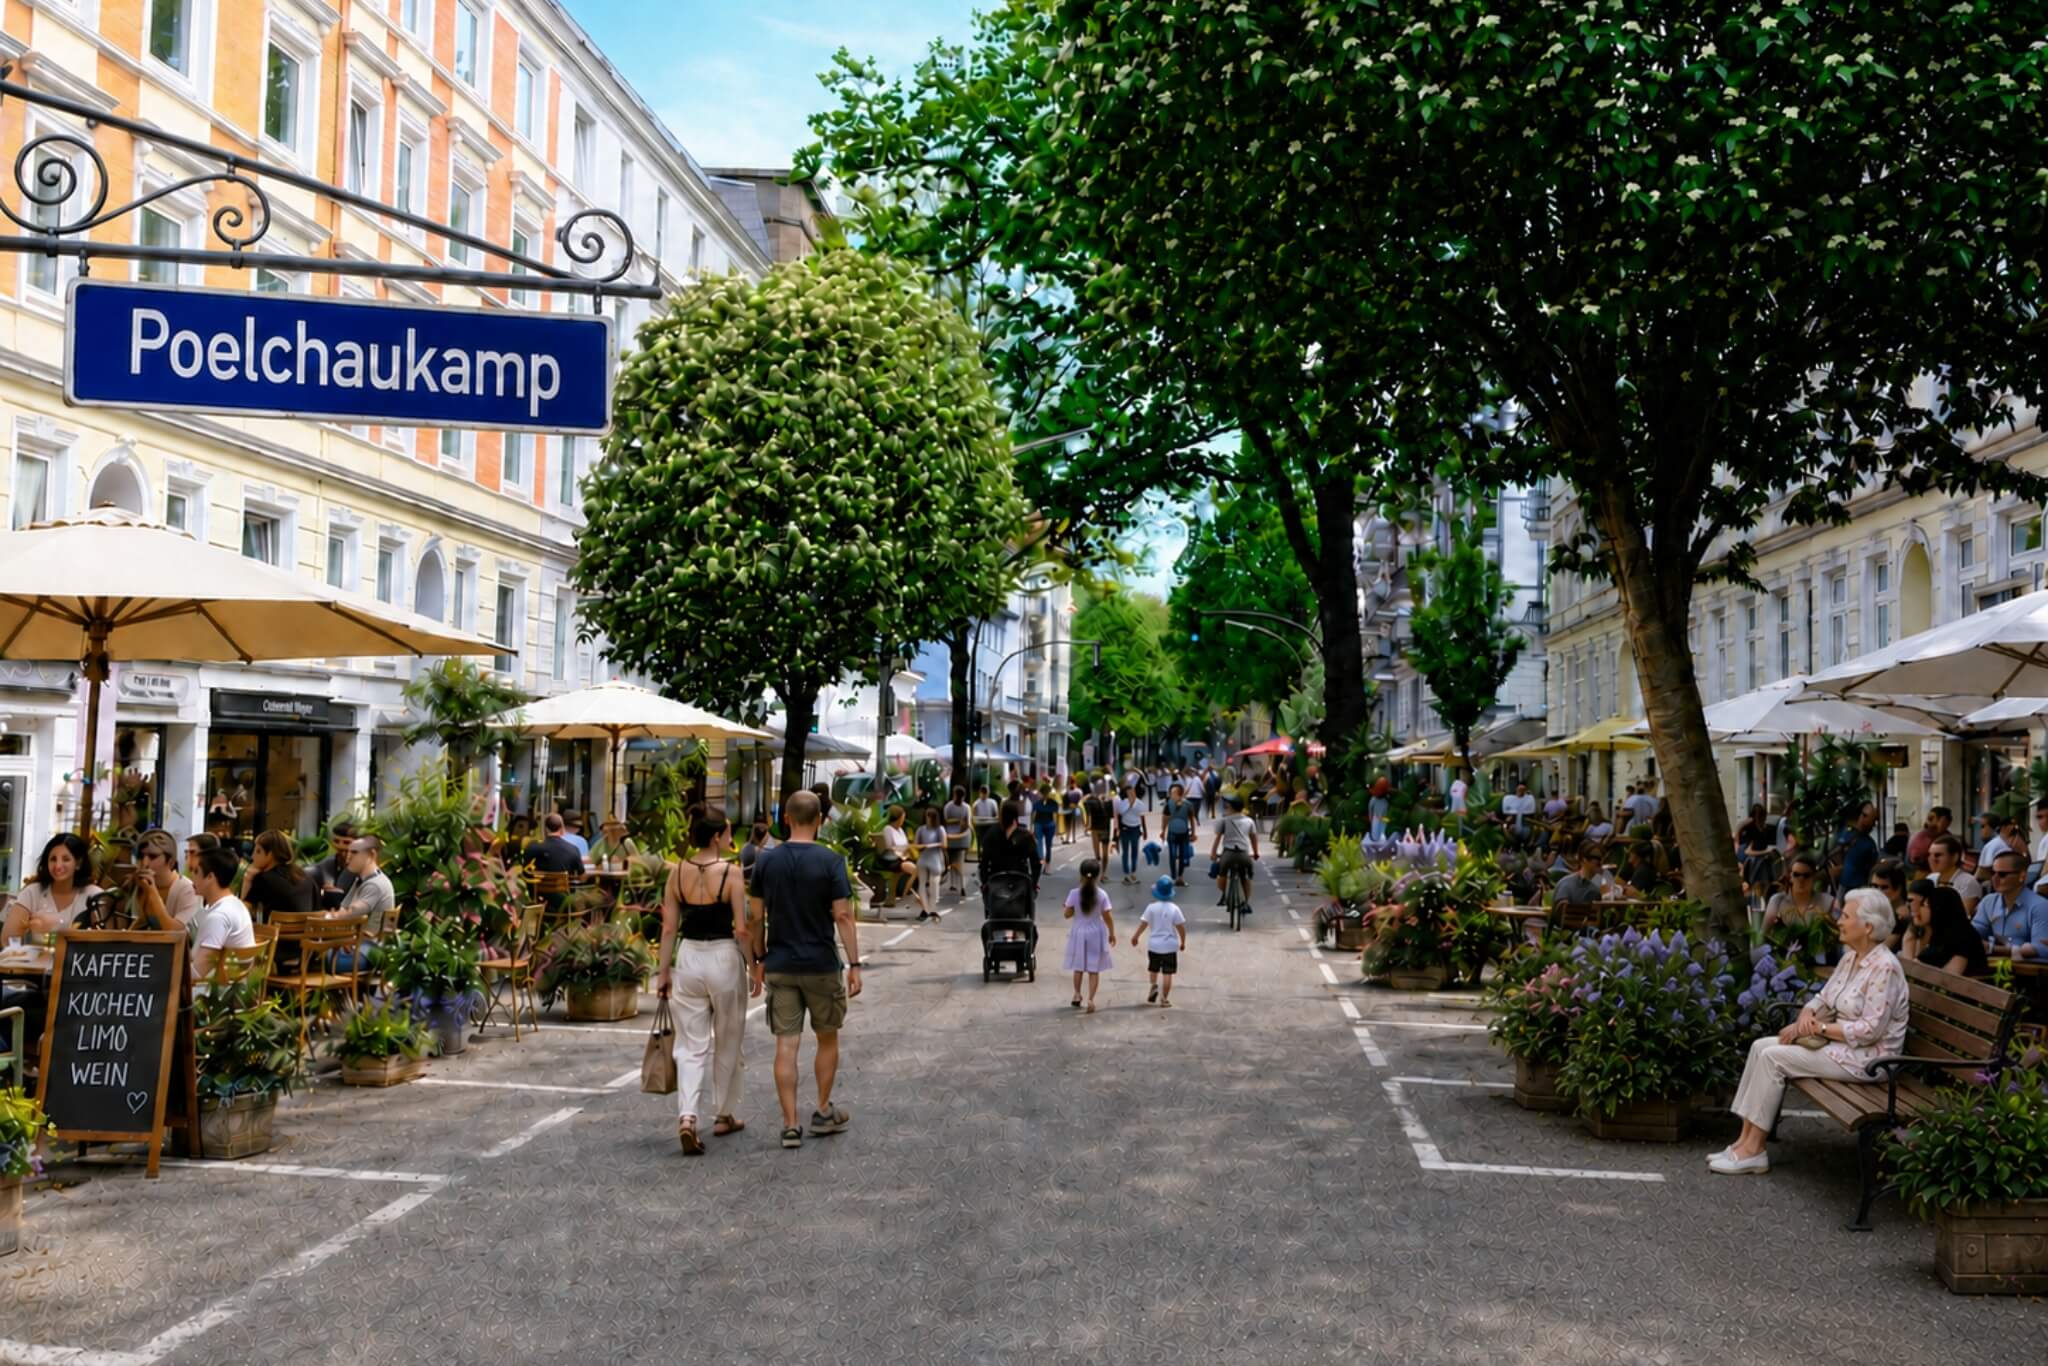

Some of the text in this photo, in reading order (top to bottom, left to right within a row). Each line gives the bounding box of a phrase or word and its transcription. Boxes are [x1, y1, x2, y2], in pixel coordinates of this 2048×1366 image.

[130, 307, 561, 417] Poelchaukamp
[71, 953, 154, 978] KAFFEE
[67, 992, 153, 1017] KUCHEN
[77, 1024, 128, 1051] LIMO
[71, 1062, 128, 1087] WEIN
